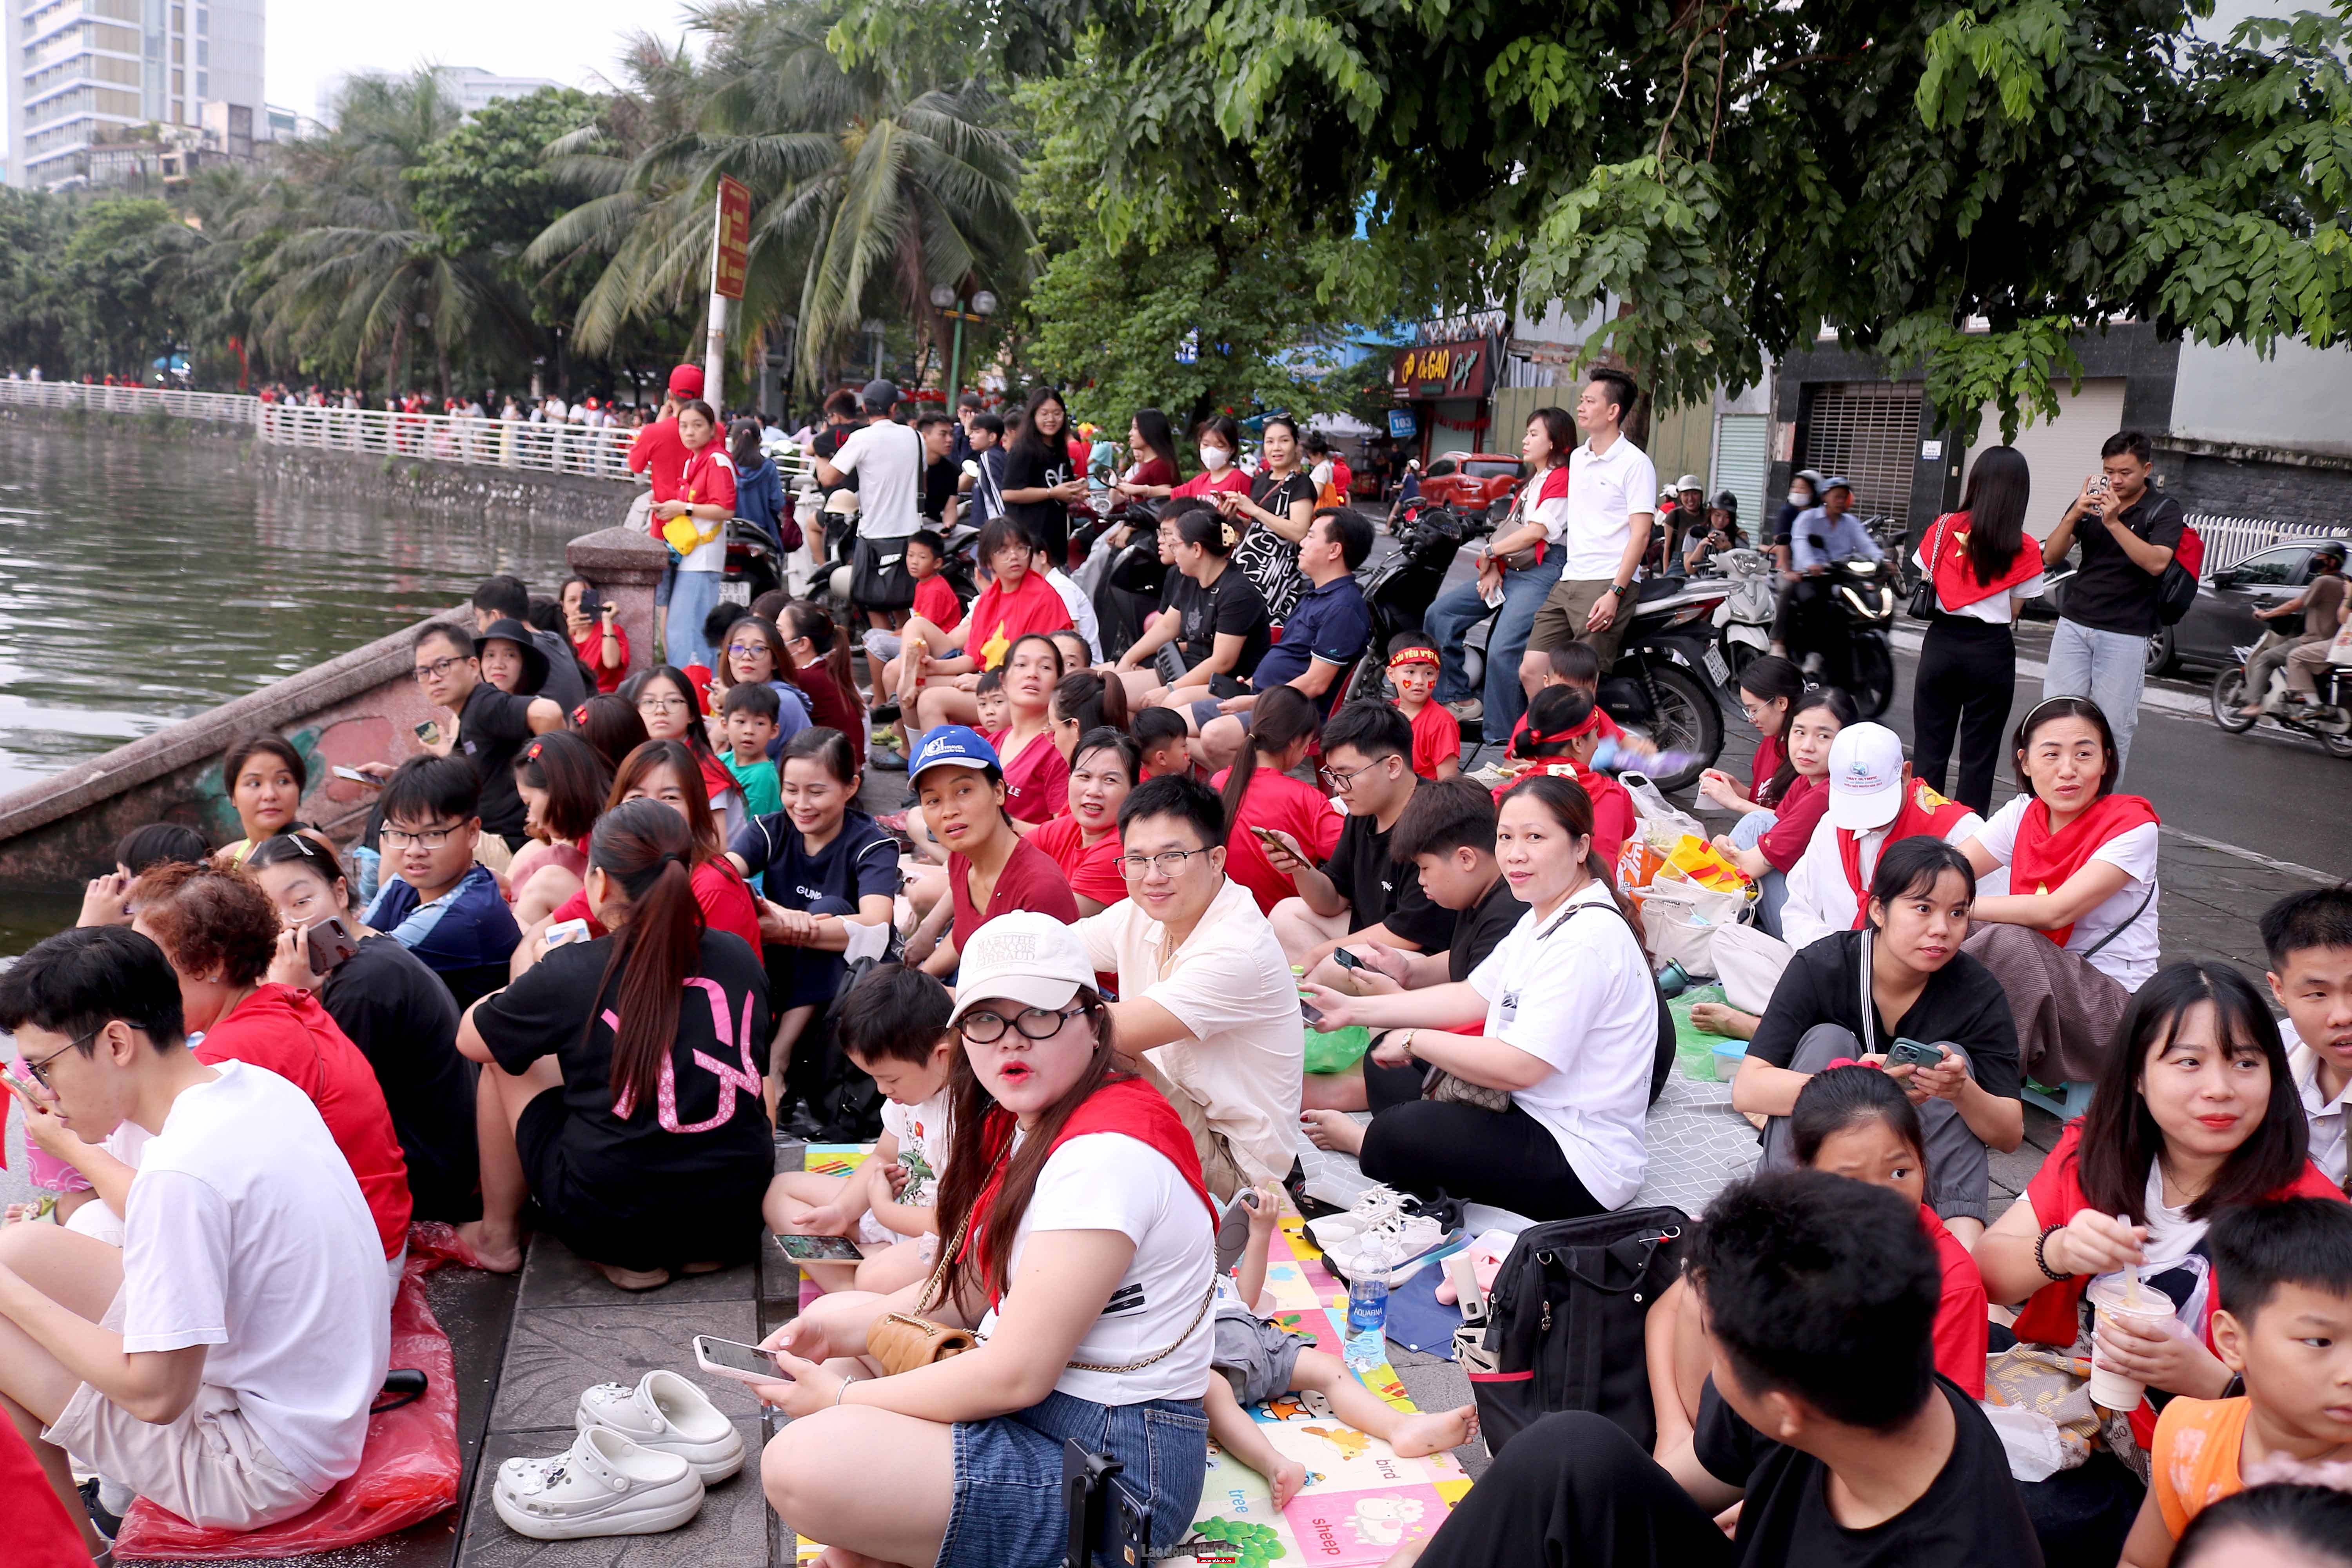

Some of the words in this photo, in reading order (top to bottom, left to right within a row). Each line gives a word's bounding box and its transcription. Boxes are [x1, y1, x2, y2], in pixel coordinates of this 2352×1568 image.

[1393, 417, 1412, 429] 103
[1405, 649, 1419, 659] YÊU
[1354, 1307, 1383, 1318] AQUAFINA
[1430, 1454, 1450, 1468] ow
[1375, 1459, 1401, 1480] bird
[1228, 1489, 1249, 1514] tree
[1312, 1517, 1341, 1556] sheep
